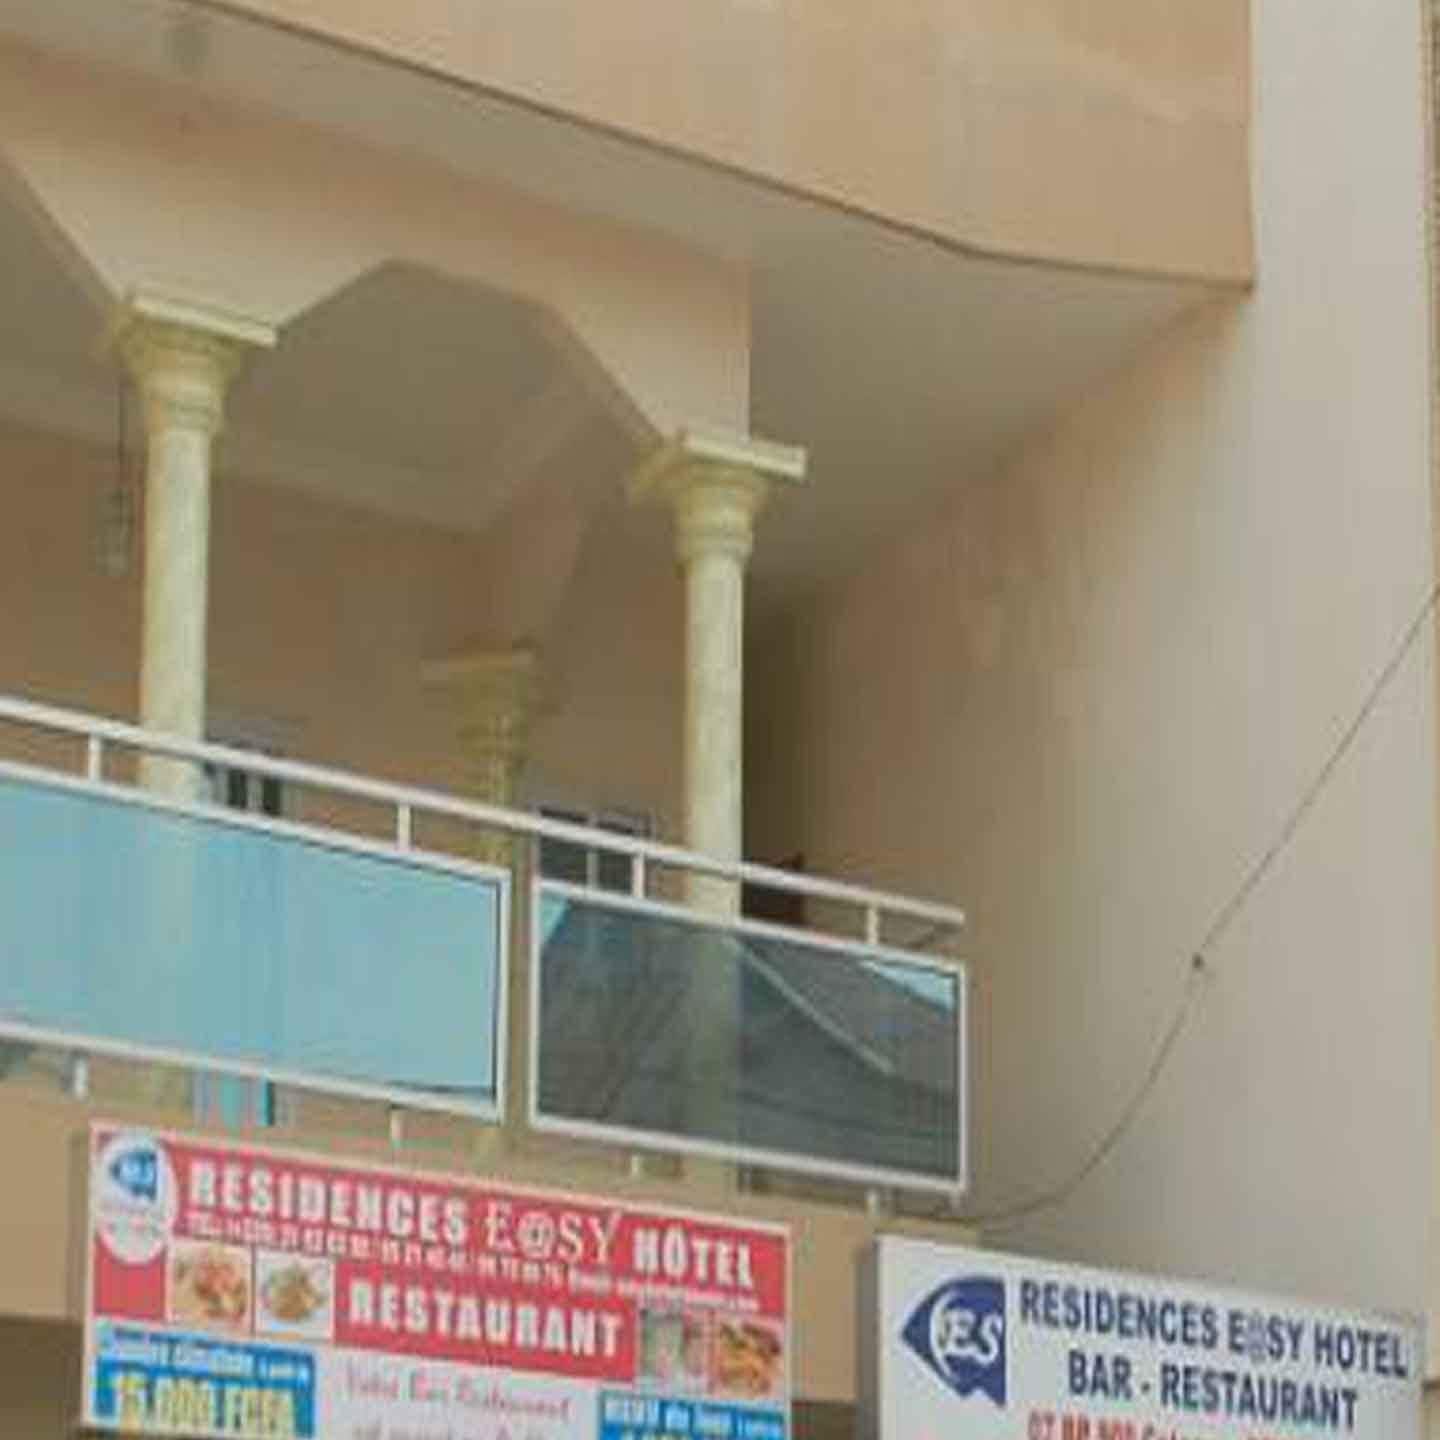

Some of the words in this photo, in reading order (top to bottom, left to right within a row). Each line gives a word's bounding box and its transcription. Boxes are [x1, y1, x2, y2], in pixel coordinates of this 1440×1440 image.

[188, 1157, 469, 1247] RESIDENCES
[487, 1199, 622, 1264] E@SY
[349, 1280, 623, 1357] RESTAURANT
[1020, 1280, 1218, 1349] RESIDENCES
[1313, 1323, 1409, 1379] HOTEL
[1068, 1349, 1133, 1400] BAR
[1160, 1362, 1358, 1431] RESTAURANT
